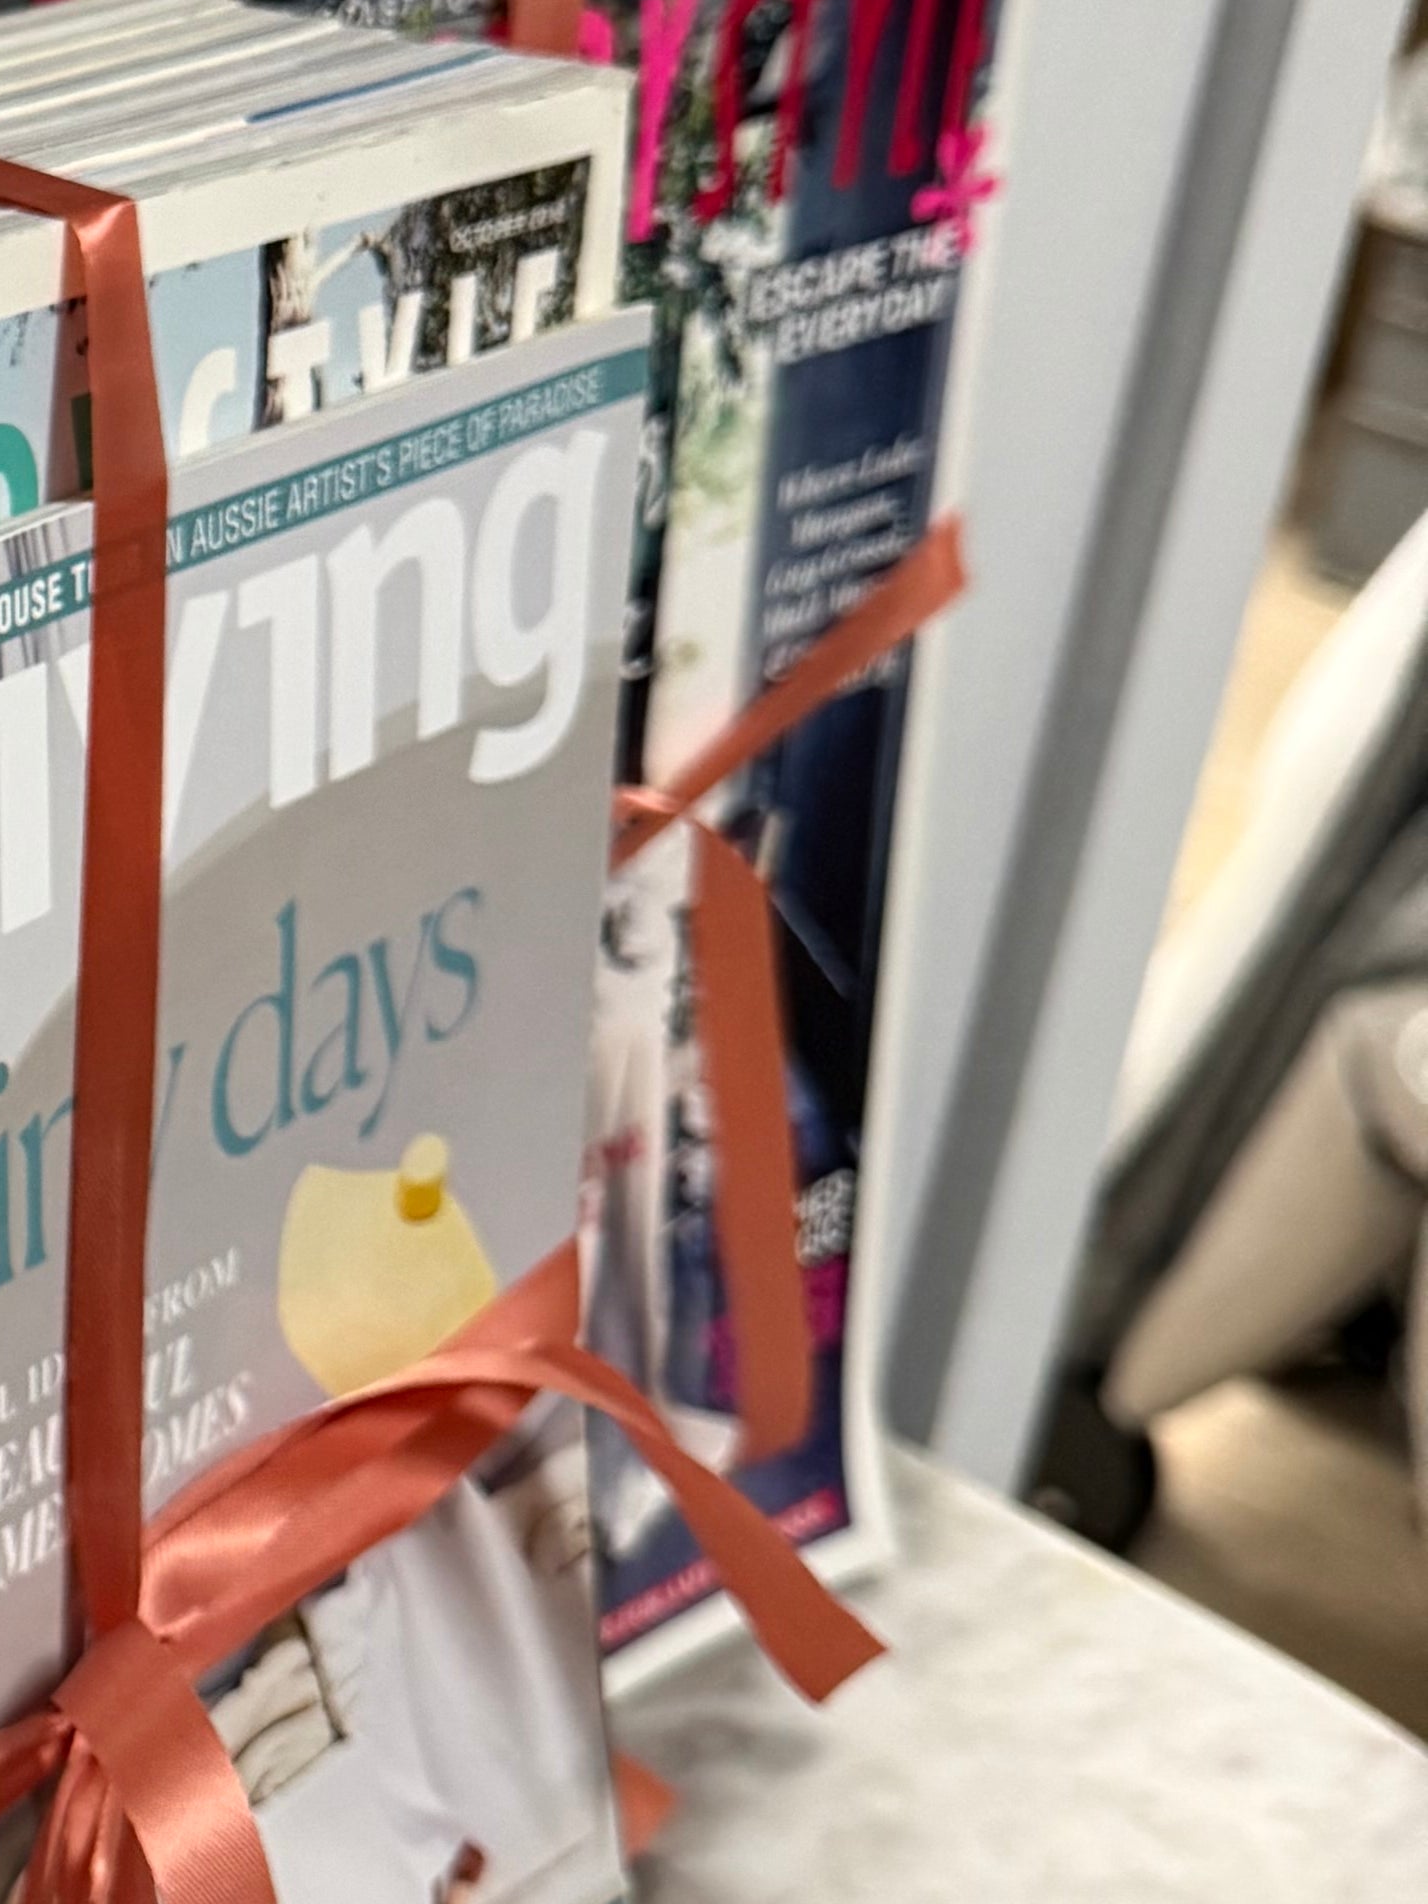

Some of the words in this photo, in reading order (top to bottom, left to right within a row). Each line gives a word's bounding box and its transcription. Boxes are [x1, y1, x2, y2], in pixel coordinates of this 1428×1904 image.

[190, 486, 281, 556] AUSSIE
[285, 446, 392, 518] ARTIST'S
[397, 421, 463, 473] PIECE
[466, 409, 497, 449] OF
[498, 366, 604, 434] PARADISE
[212, 886, 485, 1160] days
